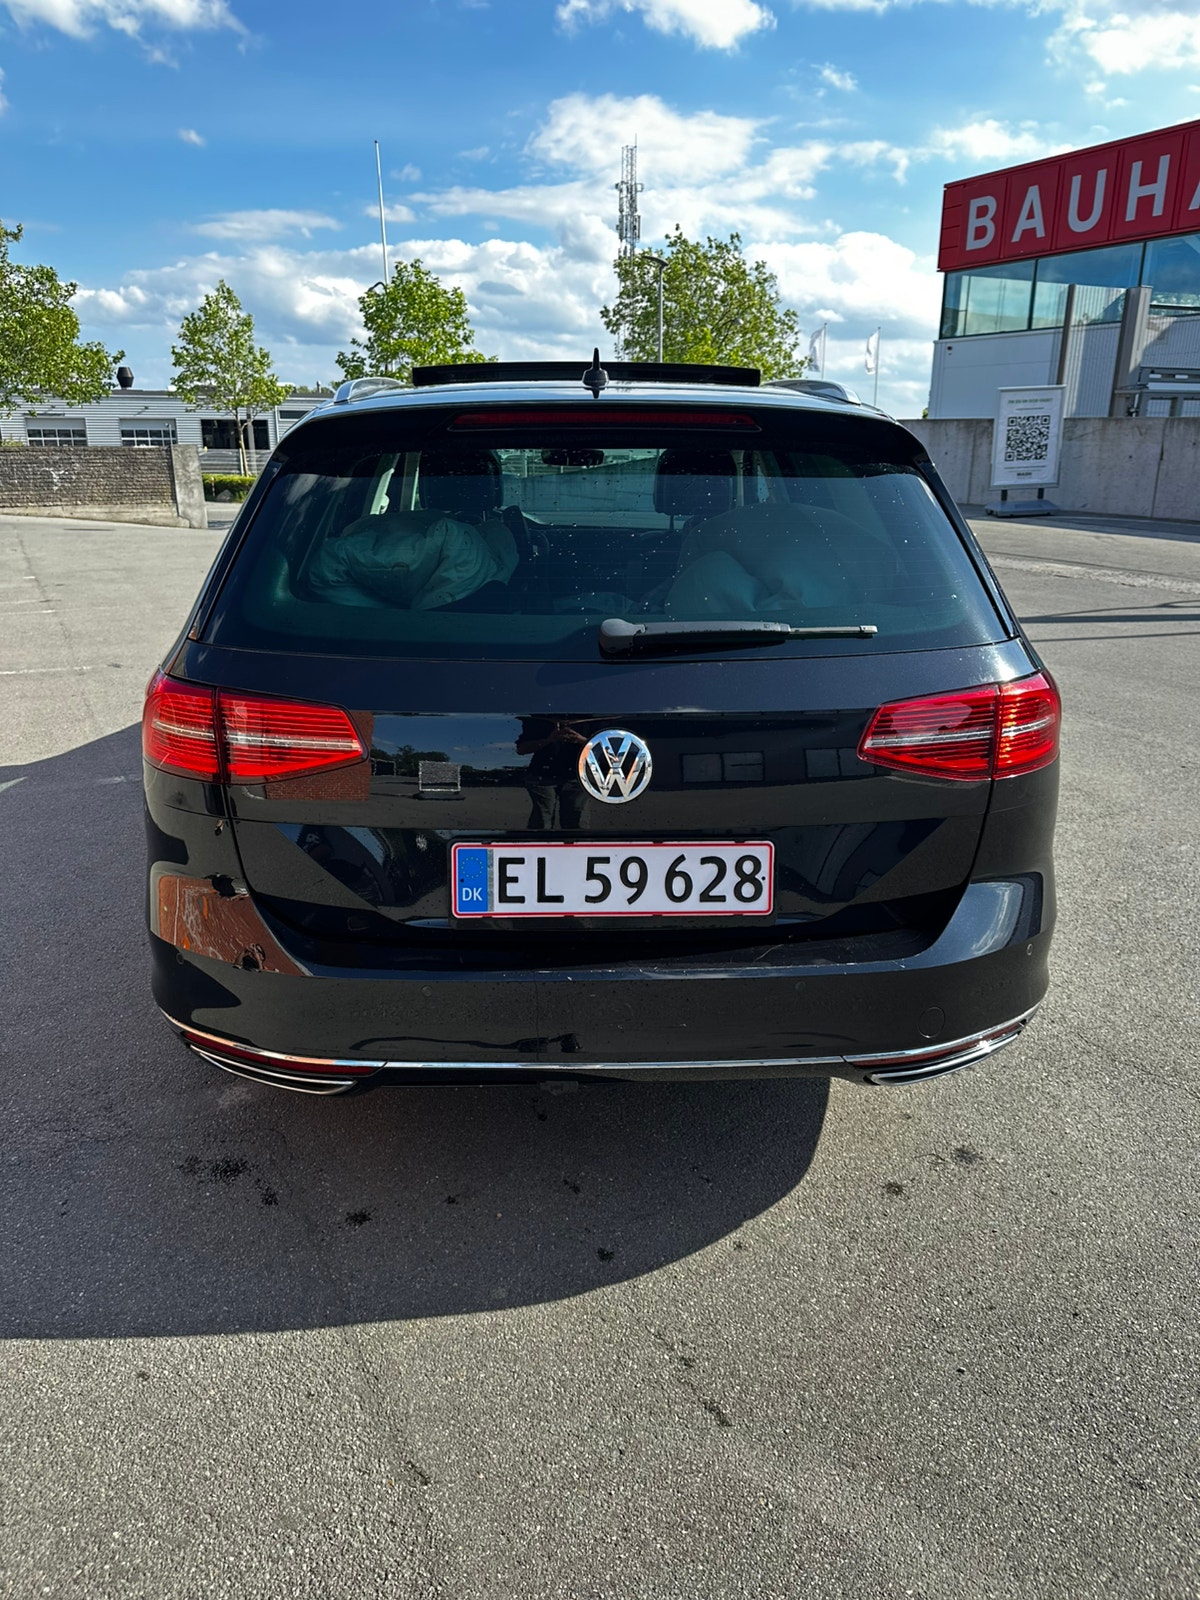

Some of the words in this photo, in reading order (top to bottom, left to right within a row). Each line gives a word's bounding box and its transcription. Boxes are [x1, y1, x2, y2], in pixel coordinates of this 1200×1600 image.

[965, 154, 1200, 251] BAUH
[462, 887, 483, 901] DK
[498, 857, 564, 903] EL
[584, 856, 648, 905] 59
[664, 854, 763, 903] 628
